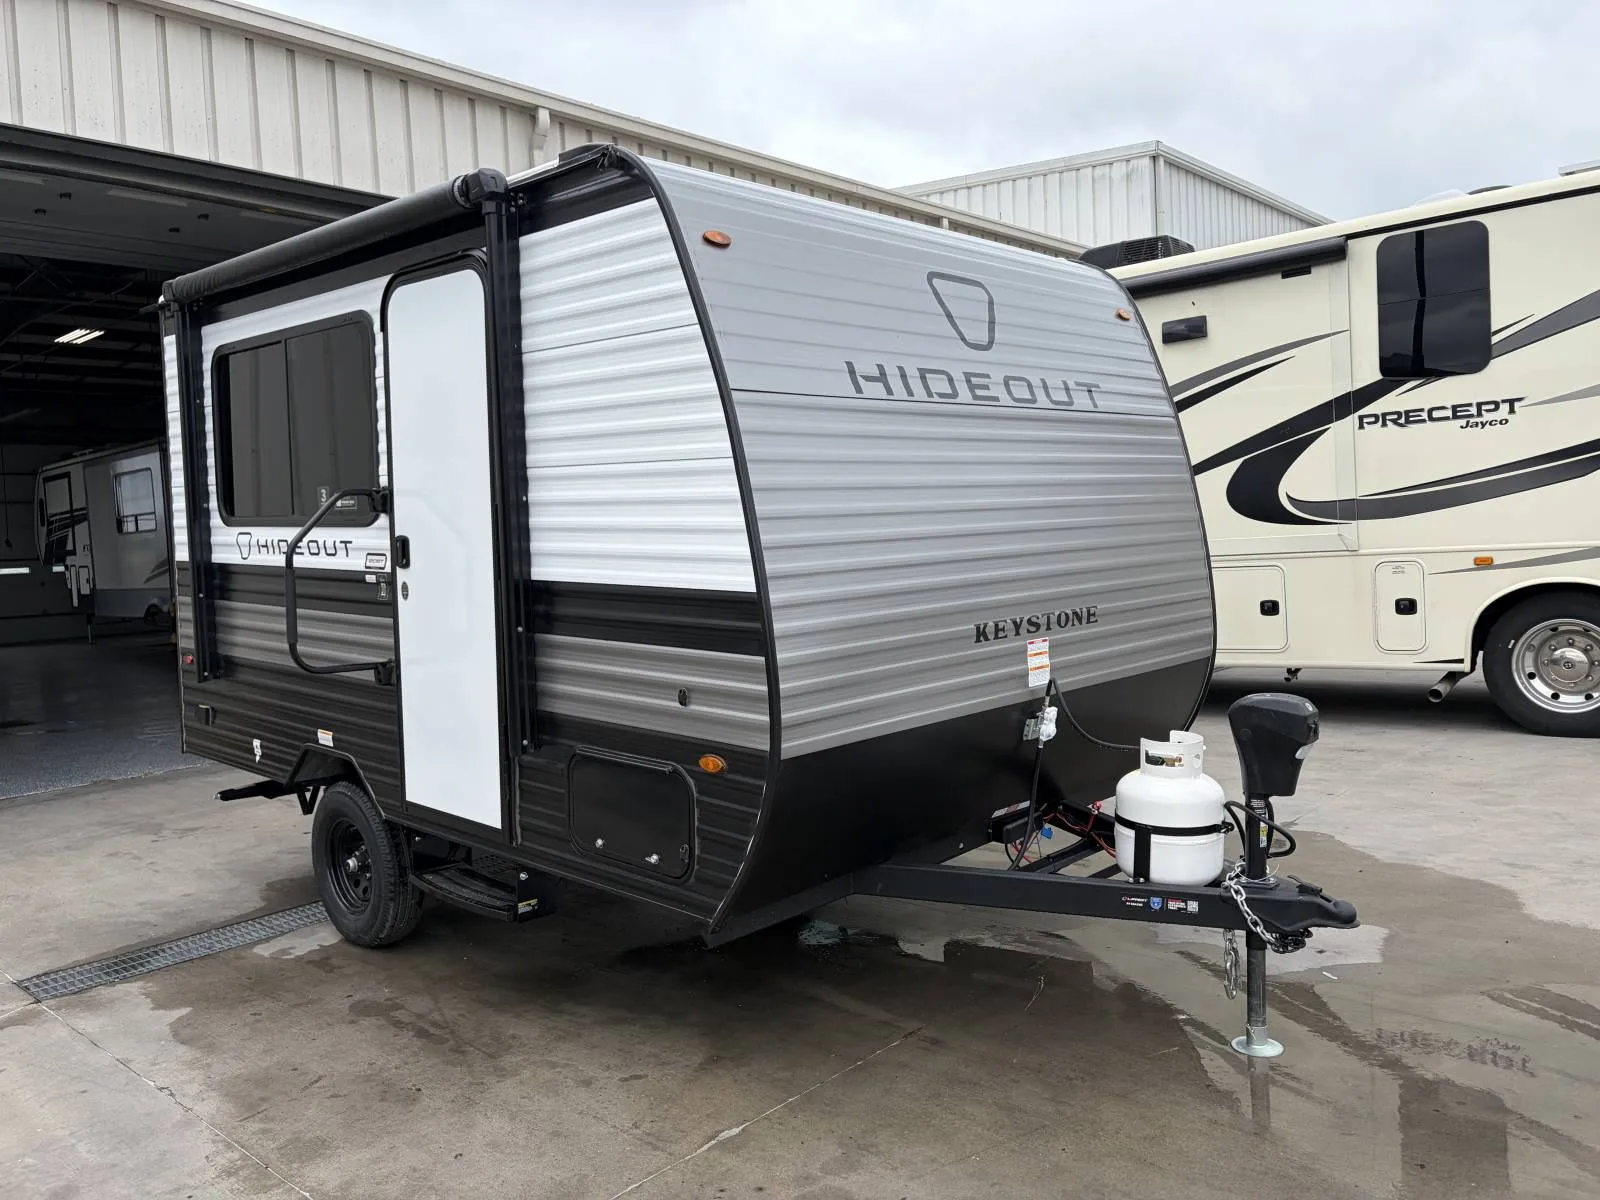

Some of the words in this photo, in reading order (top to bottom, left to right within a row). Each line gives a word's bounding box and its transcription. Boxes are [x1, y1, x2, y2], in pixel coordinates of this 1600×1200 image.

[844, 360, 1102, 409] HIDEOUT
[1358, 396, 1528, 430] PRECEPT
[1459, 418, 1510, 430] Jayco
[973, 605, 1099, 643] KEYSTONE
